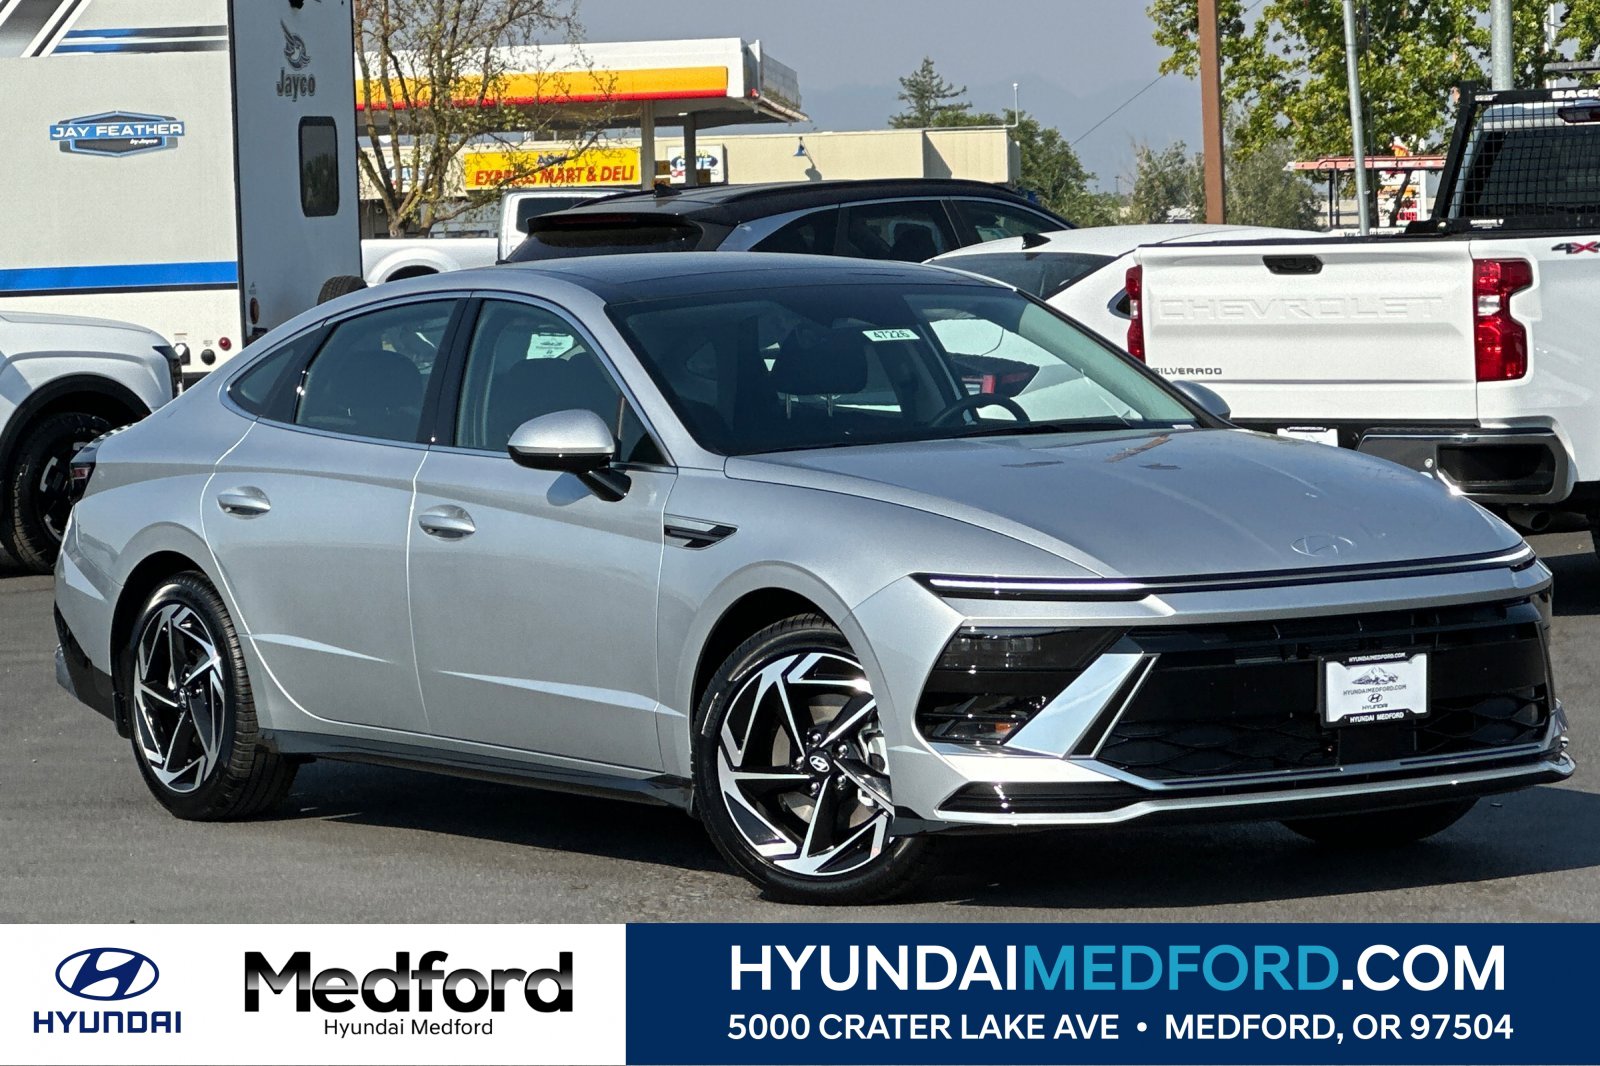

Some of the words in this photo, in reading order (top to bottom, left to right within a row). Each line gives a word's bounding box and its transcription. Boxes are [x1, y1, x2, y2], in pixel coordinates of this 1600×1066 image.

[276, 67, 316, 102] Jayco
[52, 126, 90, 138] JAY
[96, 123, 183, 136] FEATHER
[540, 167, 584, 184] MART
[587, 166, 597, 182] &
[600, 165, 634, 181] DELI
[1158, 296, 1444, 320] CHEVROLET
[1151, 367, 1222, 375] SILVERADO
[1348, 652, 1406, 662] HYUNDAIMEDFORD.COM
[1343, 684, 1407, 696] HYUNDAIMEDFORD.COM
[1349, 714, 1375, 723] HYUNDAI
[1376, 711, 1405, 721] MEDFORD
